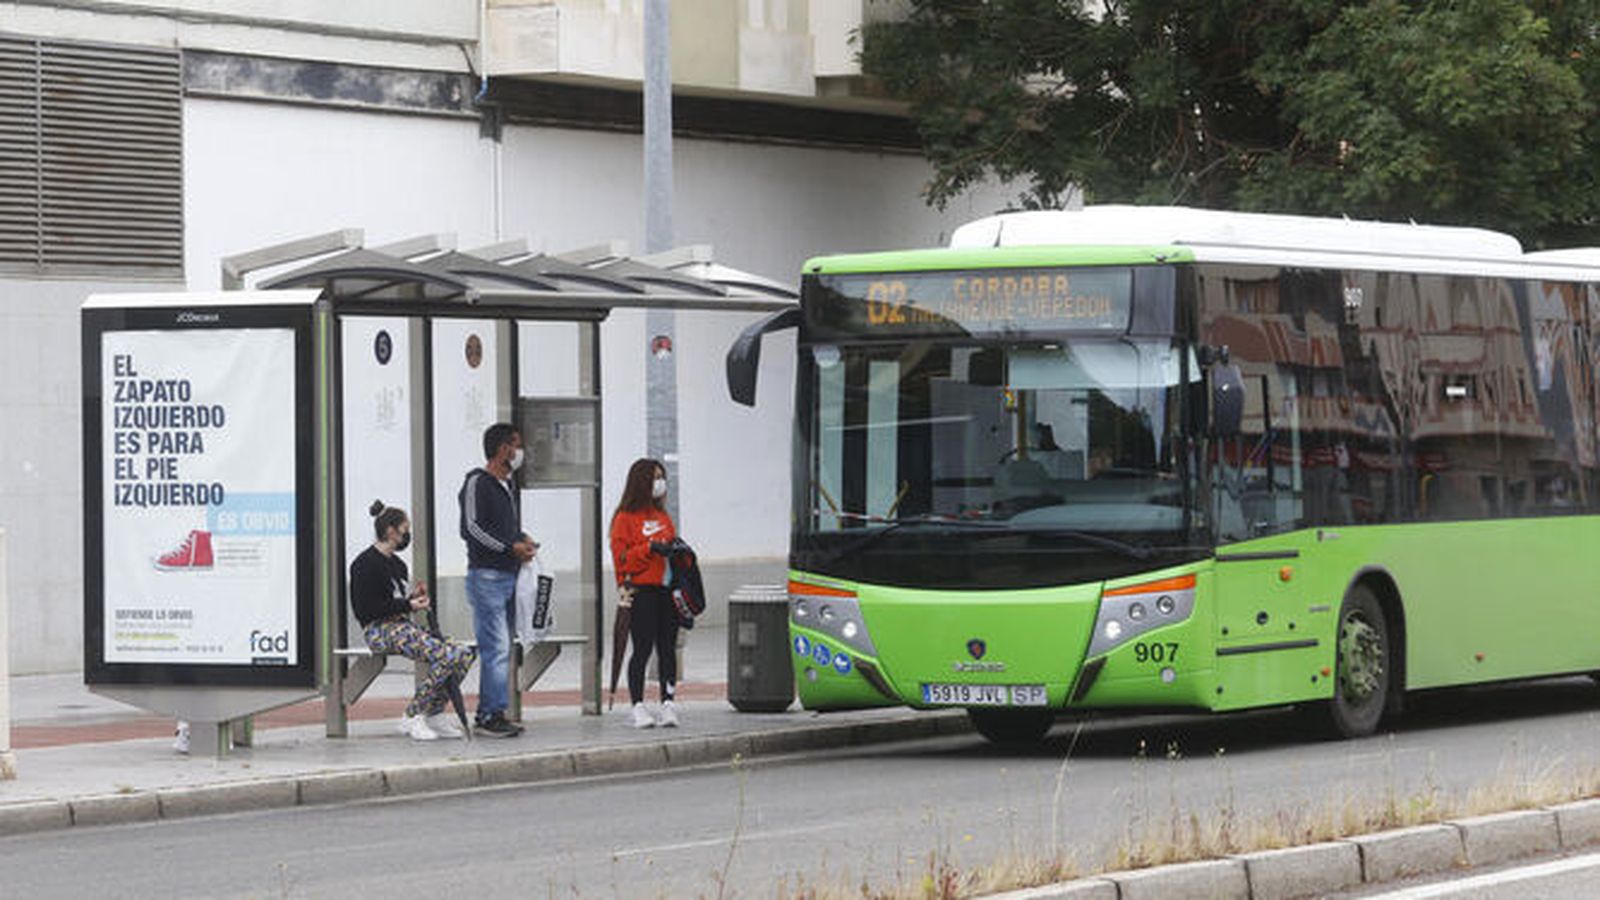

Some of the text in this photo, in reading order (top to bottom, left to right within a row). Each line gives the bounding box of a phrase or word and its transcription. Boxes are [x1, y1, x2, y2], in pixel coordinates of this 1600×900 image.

[867, 274, 1070, 325] 02 CORDOBA
[114, 354, 138, 377] EL
[114, 379, 191, 402] ZAPATO
[114, 404, 225, 430] IZQUIERDO
[114, 431, 204, 454] ES PARA
[114, 457, 178, 480] EL PIE
[114, 482, 225, 508] IZQUIERDO
[250, 630, 289, 653] fad
[1134, 641, 1179, 663] 907
[931, 684, 971, 702] 5919
[1014, 686, 1043, 703] SP
